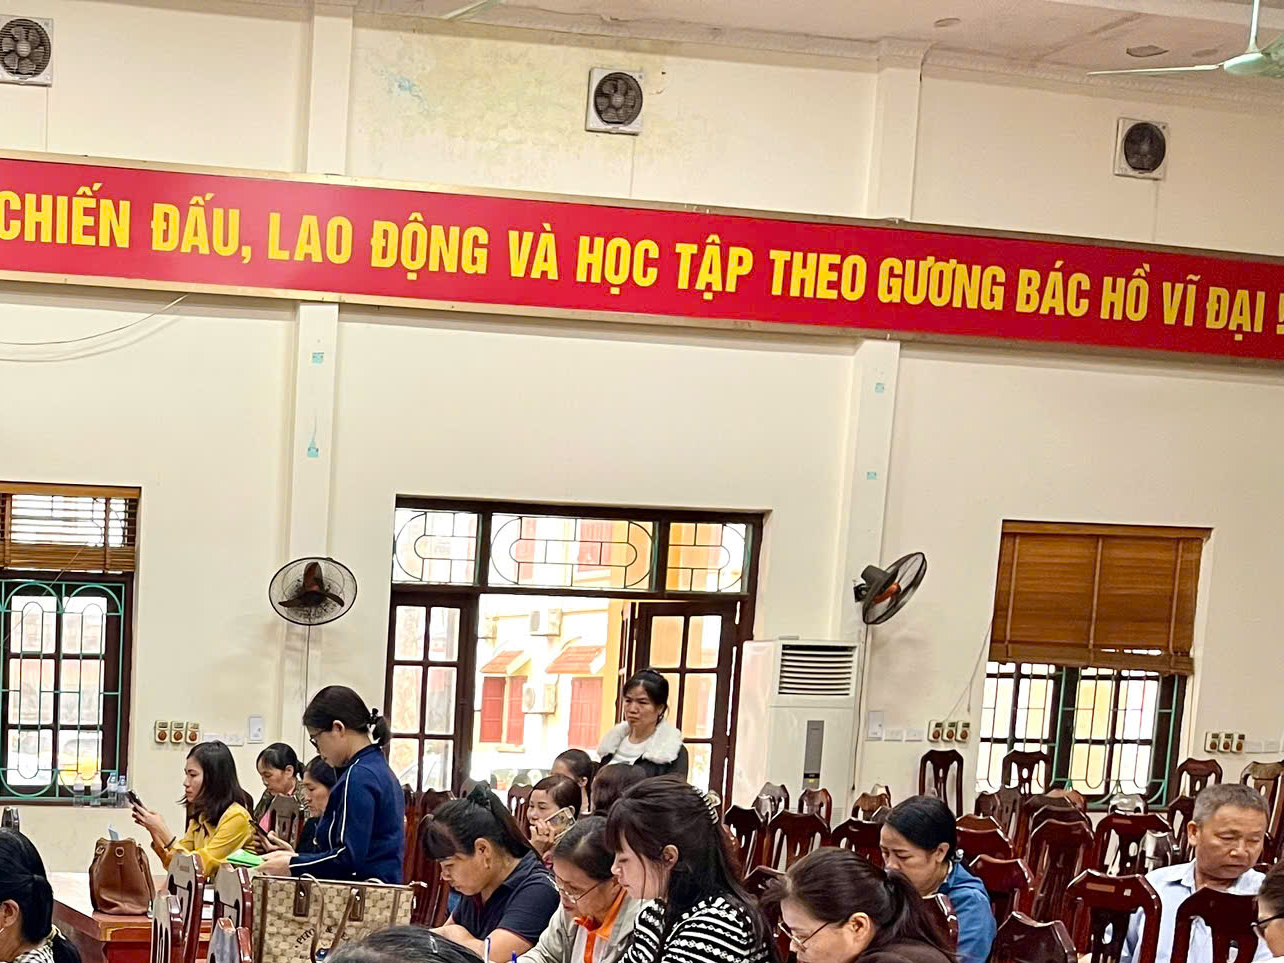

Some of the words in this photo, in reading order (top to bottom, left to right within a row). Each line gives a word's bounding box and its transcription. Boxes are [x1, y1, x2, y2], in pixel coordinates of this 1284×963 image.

[151, 192, 253, 265] ĐẤU,
[268, 212, 353, 264] LAO
[370, 212, 488, 281] ĐỘNG
[508, 223, 559, 281] VÀ
[576, 236, 660, 295] HỌC
[676, 233, 753, 302] TẬP
[770, 249, 867, 301] THEO
[877, 255, 1006, 311] GƯƠNG
[1015, 260, 1091, 317] BÁC
[1100, 263, 1150, 322] HỒ
[1163, 273, 1198, 327] VĨ
[1206, 286, 1265, 341] ĐẠI
